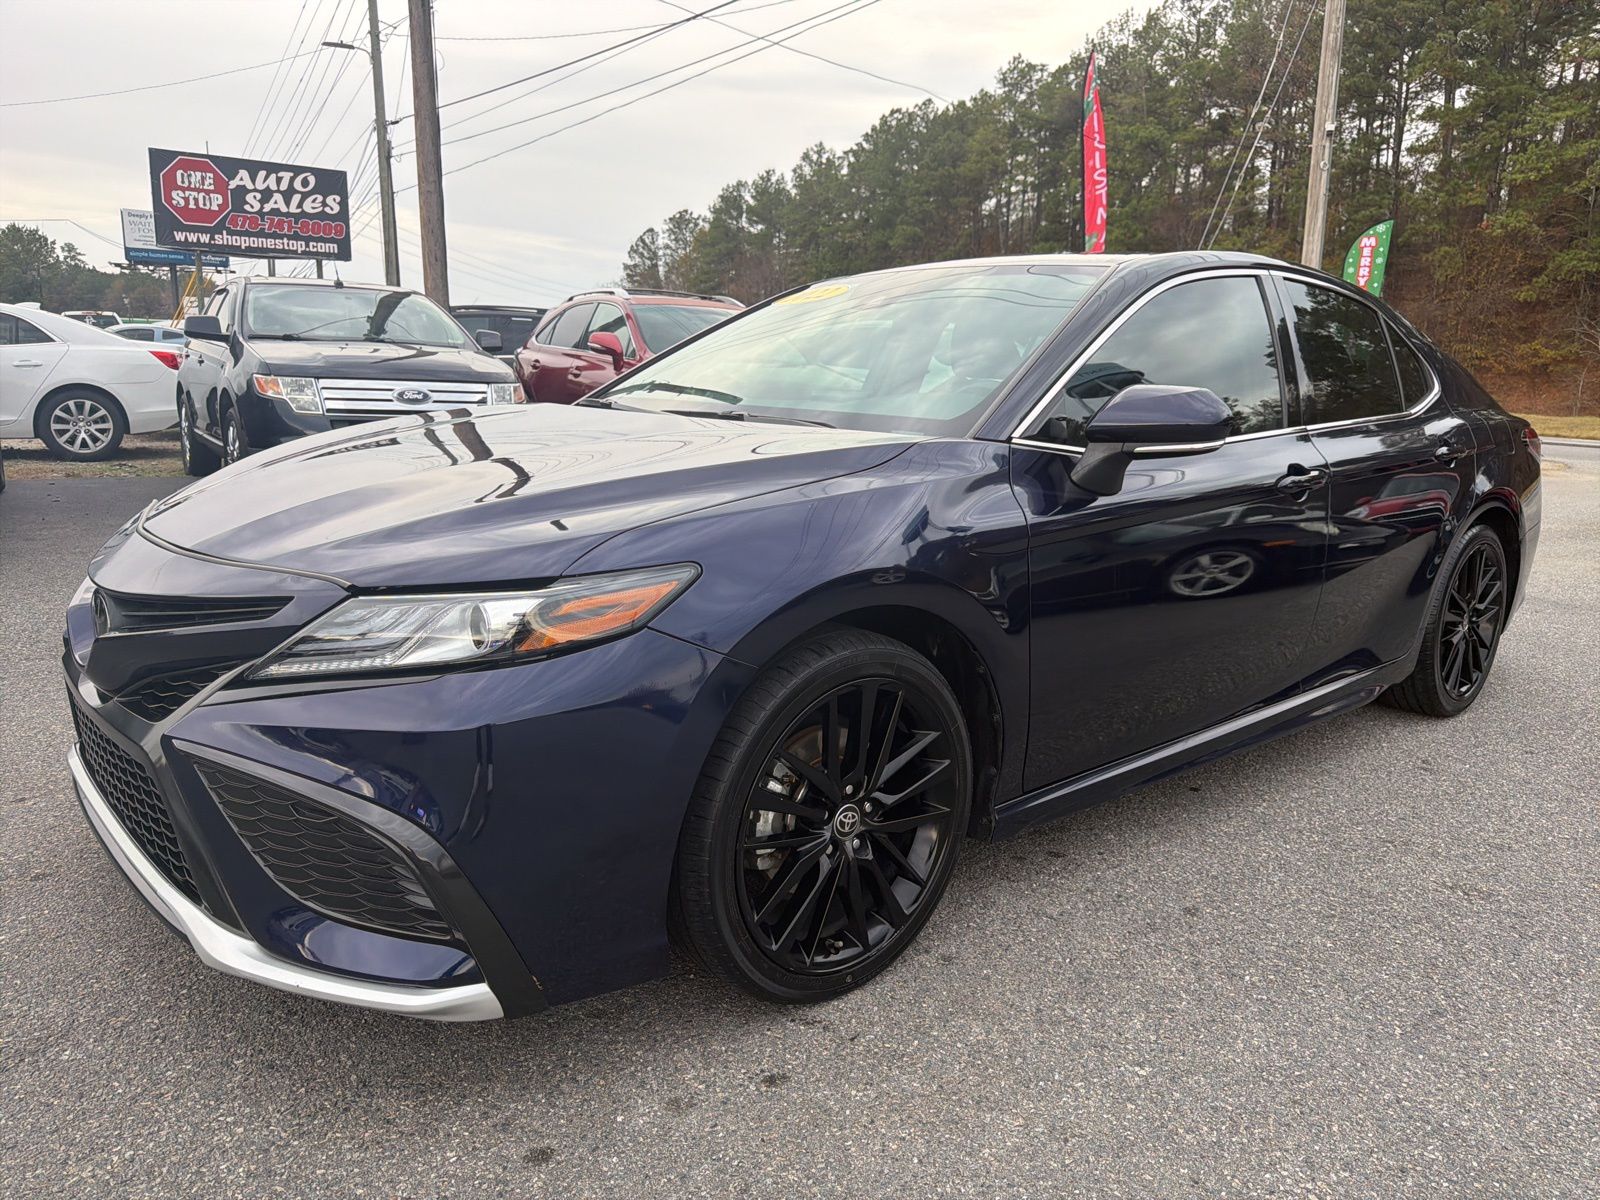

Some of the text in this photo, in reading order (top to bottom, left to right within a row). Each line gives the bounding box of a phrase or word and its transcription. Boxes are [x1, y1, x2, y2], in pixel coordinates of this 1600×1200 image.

[176, 169, 214, 190] ONE
[228, 169, 316, 192] AUTO
[171, 190, 223, 211] STOP
[127, 211, 149, 220] Deeply
[226, 212, 346, 239] 478-741-8009
[173, 230, 338, 254] www.shoponestop.com
[1357, 236, 1377, 286] MERRY
[403, 390, 424, 400] Ford
